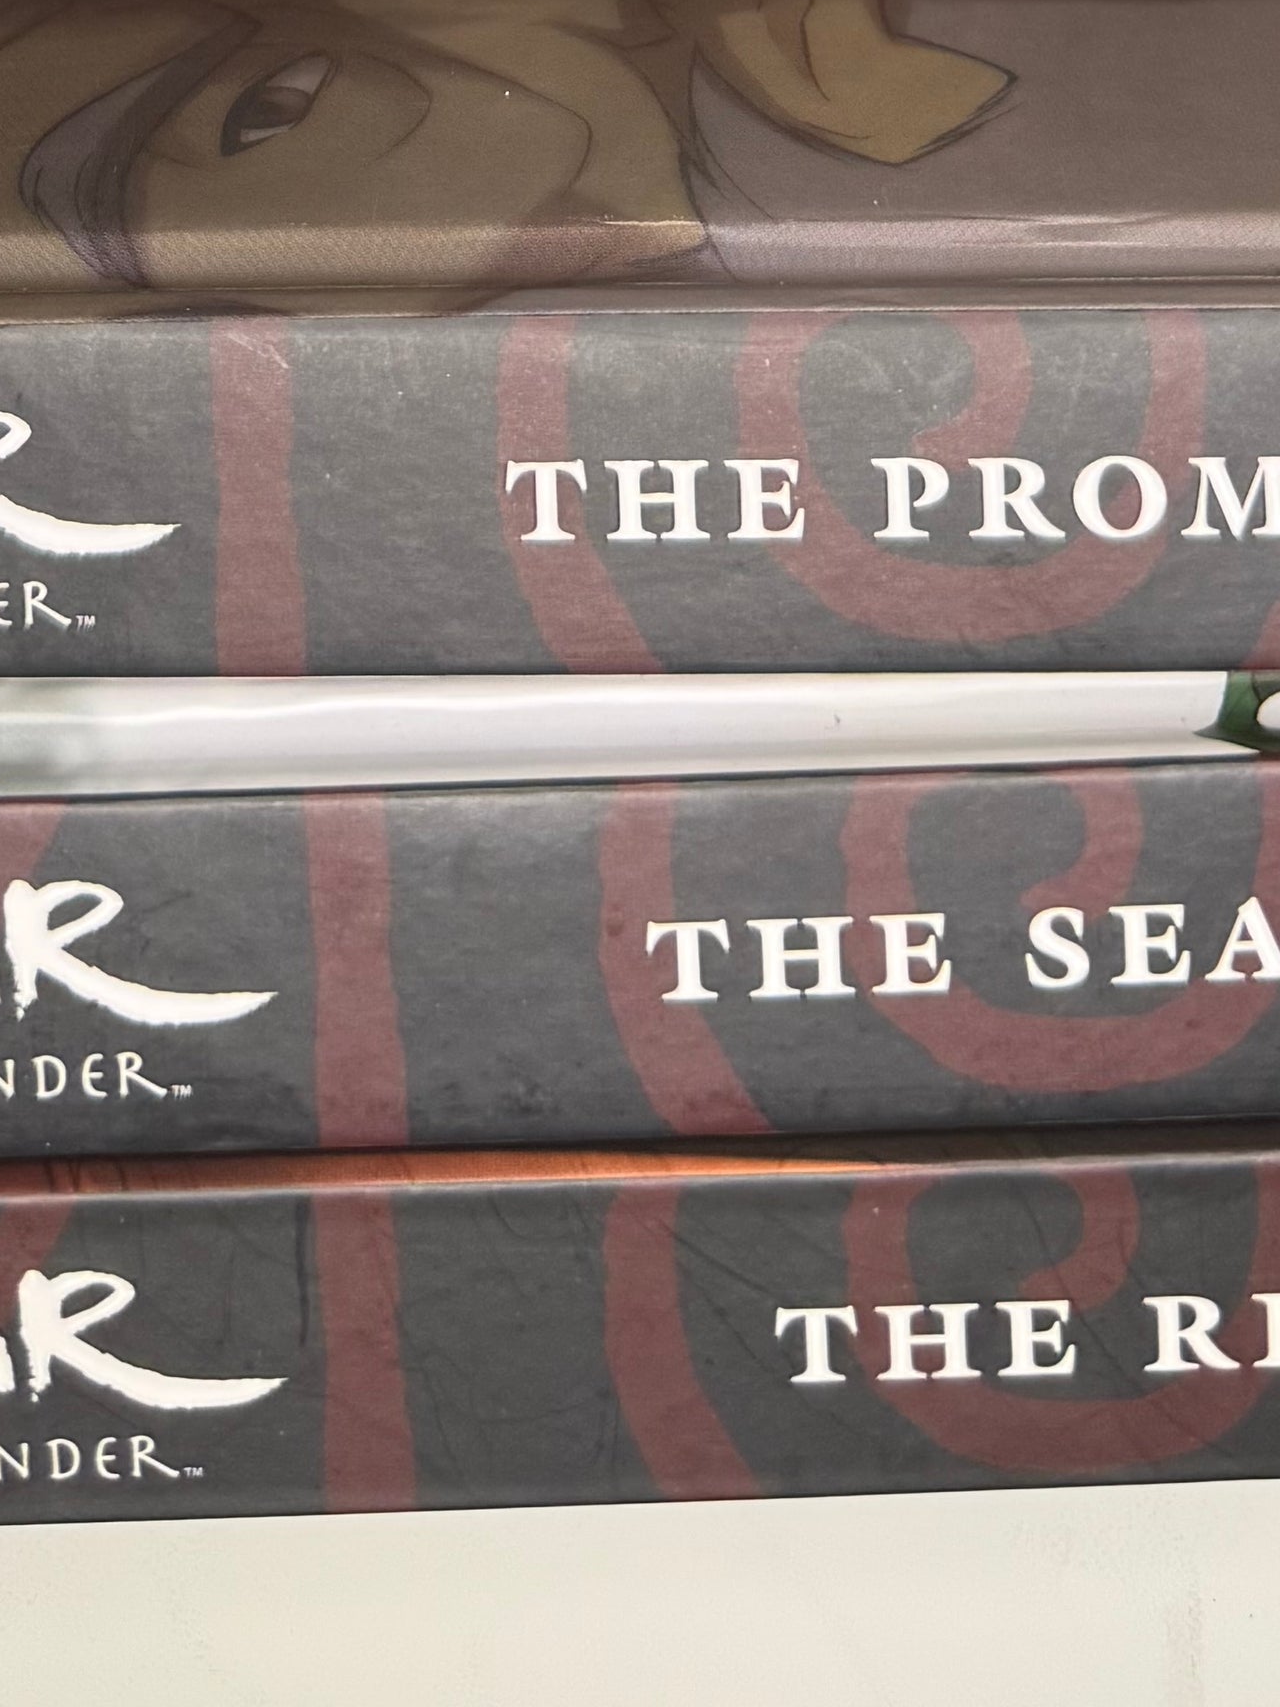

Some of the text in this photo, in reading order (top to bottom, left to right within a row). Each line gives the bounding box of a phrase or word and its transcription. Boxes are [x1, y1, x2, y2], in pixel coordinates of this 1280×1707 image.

[503, 455, 807, 546] THE
[644, 911, 953, 1004] THE
[773, 1298, 1077, 1385] THE
